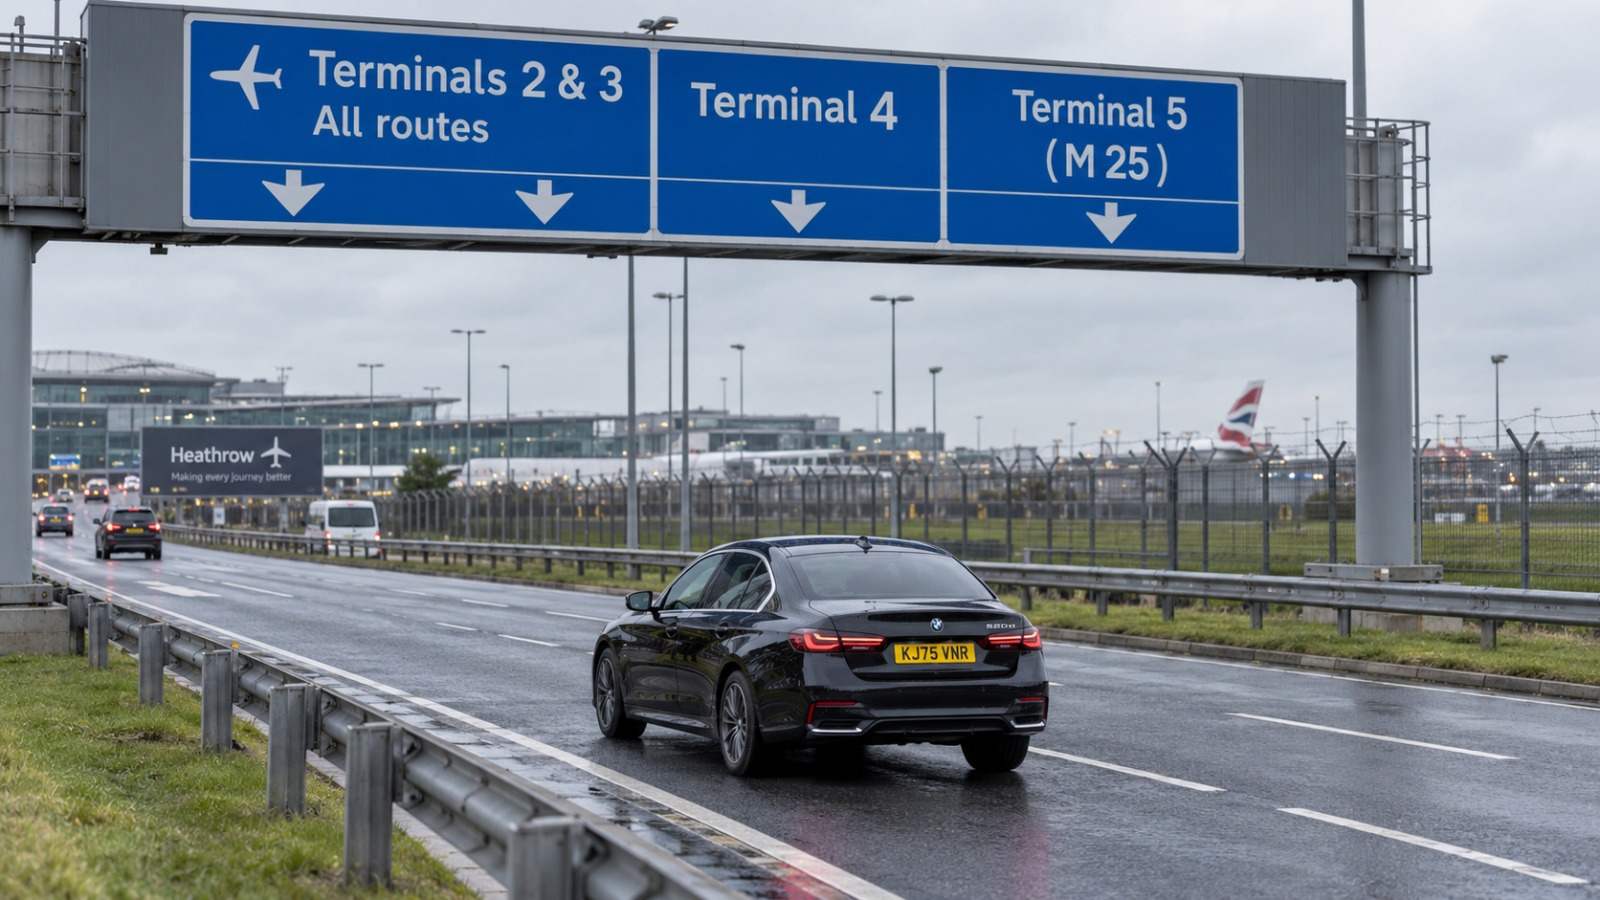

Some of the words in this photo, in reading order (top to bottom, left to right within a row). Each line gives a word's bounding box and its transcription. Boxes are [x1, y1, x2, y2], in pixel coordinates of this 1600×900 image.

[310, 50, 507, 96] Terminals
[523, 61, 546, 98] 2
[559, 64, 586, 100] &
[600, 66, 623, 103] 3
[313, 105, 363, 138] All
[378, 113, 489, 143] routes
[691, 82, 857, 124] Terminal
[871, 92, 898, 130] 4
[1013, 90, 1155, 128] Terminal
[1168, 96, 1188, 131] 5
[171, 446, 255, 463] Heathrow
[171, 472, 203, 483] Making
[205, 474, 230, 483] every
[231, 472, 264, 483] journey
[266, 472, 292, 482] better
[901, 646, 938, 661] KJ75
[942, 645, 969, 660] VNR
